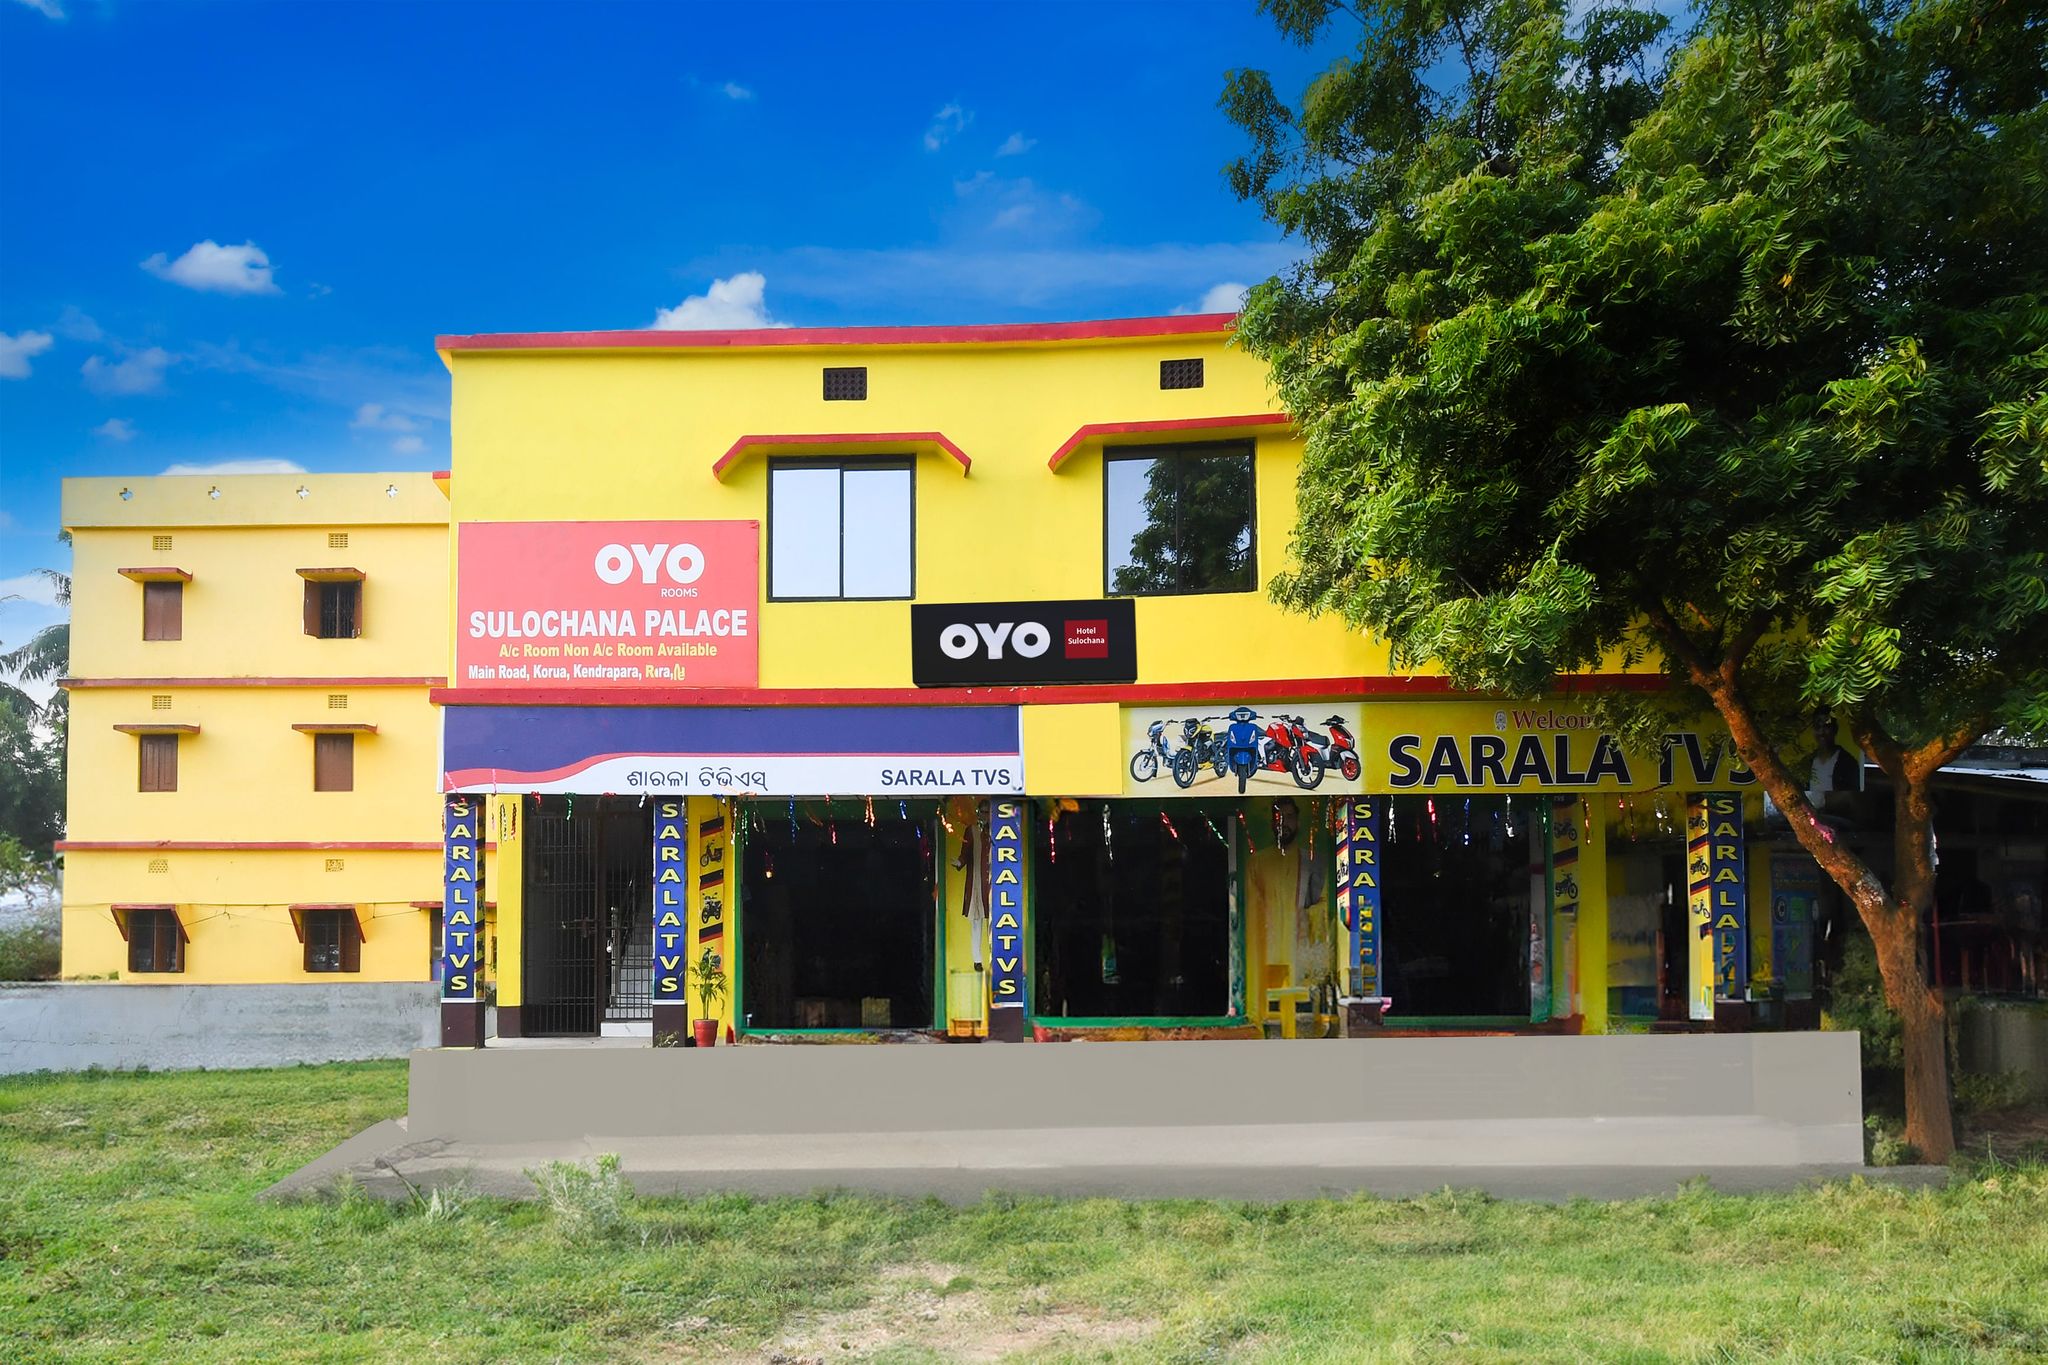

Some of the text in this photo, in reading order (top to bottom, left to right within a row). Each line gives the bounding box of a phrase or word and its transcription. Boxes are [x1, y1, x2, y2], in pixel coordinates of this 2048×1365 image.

[594, 543, 705, 584] OYO
[661, 587, 698, 598] ROOMS
[469, 609, 748, 638] SULOCHANA PALACE
[1076, 627, 1096, 635] Hotel
[939, 621, 1051, 659] OYO
[1068, 636, 1105, 645] Sulochana
[499, 642, 718, 658] A/c Room Non A/c Room Available
[468, 664, 495, 680] Main
[499, 664, 530, 681] Road,
[533, 664, 570, 681] Korua,
[573, 663, 642, 681] Kendrapara,
[1388, 733, 1632, 787] SARALA
[626, 770, 688, 787] ଶାରଳା
[881, 768, 1011, 787] SARALA TVS
